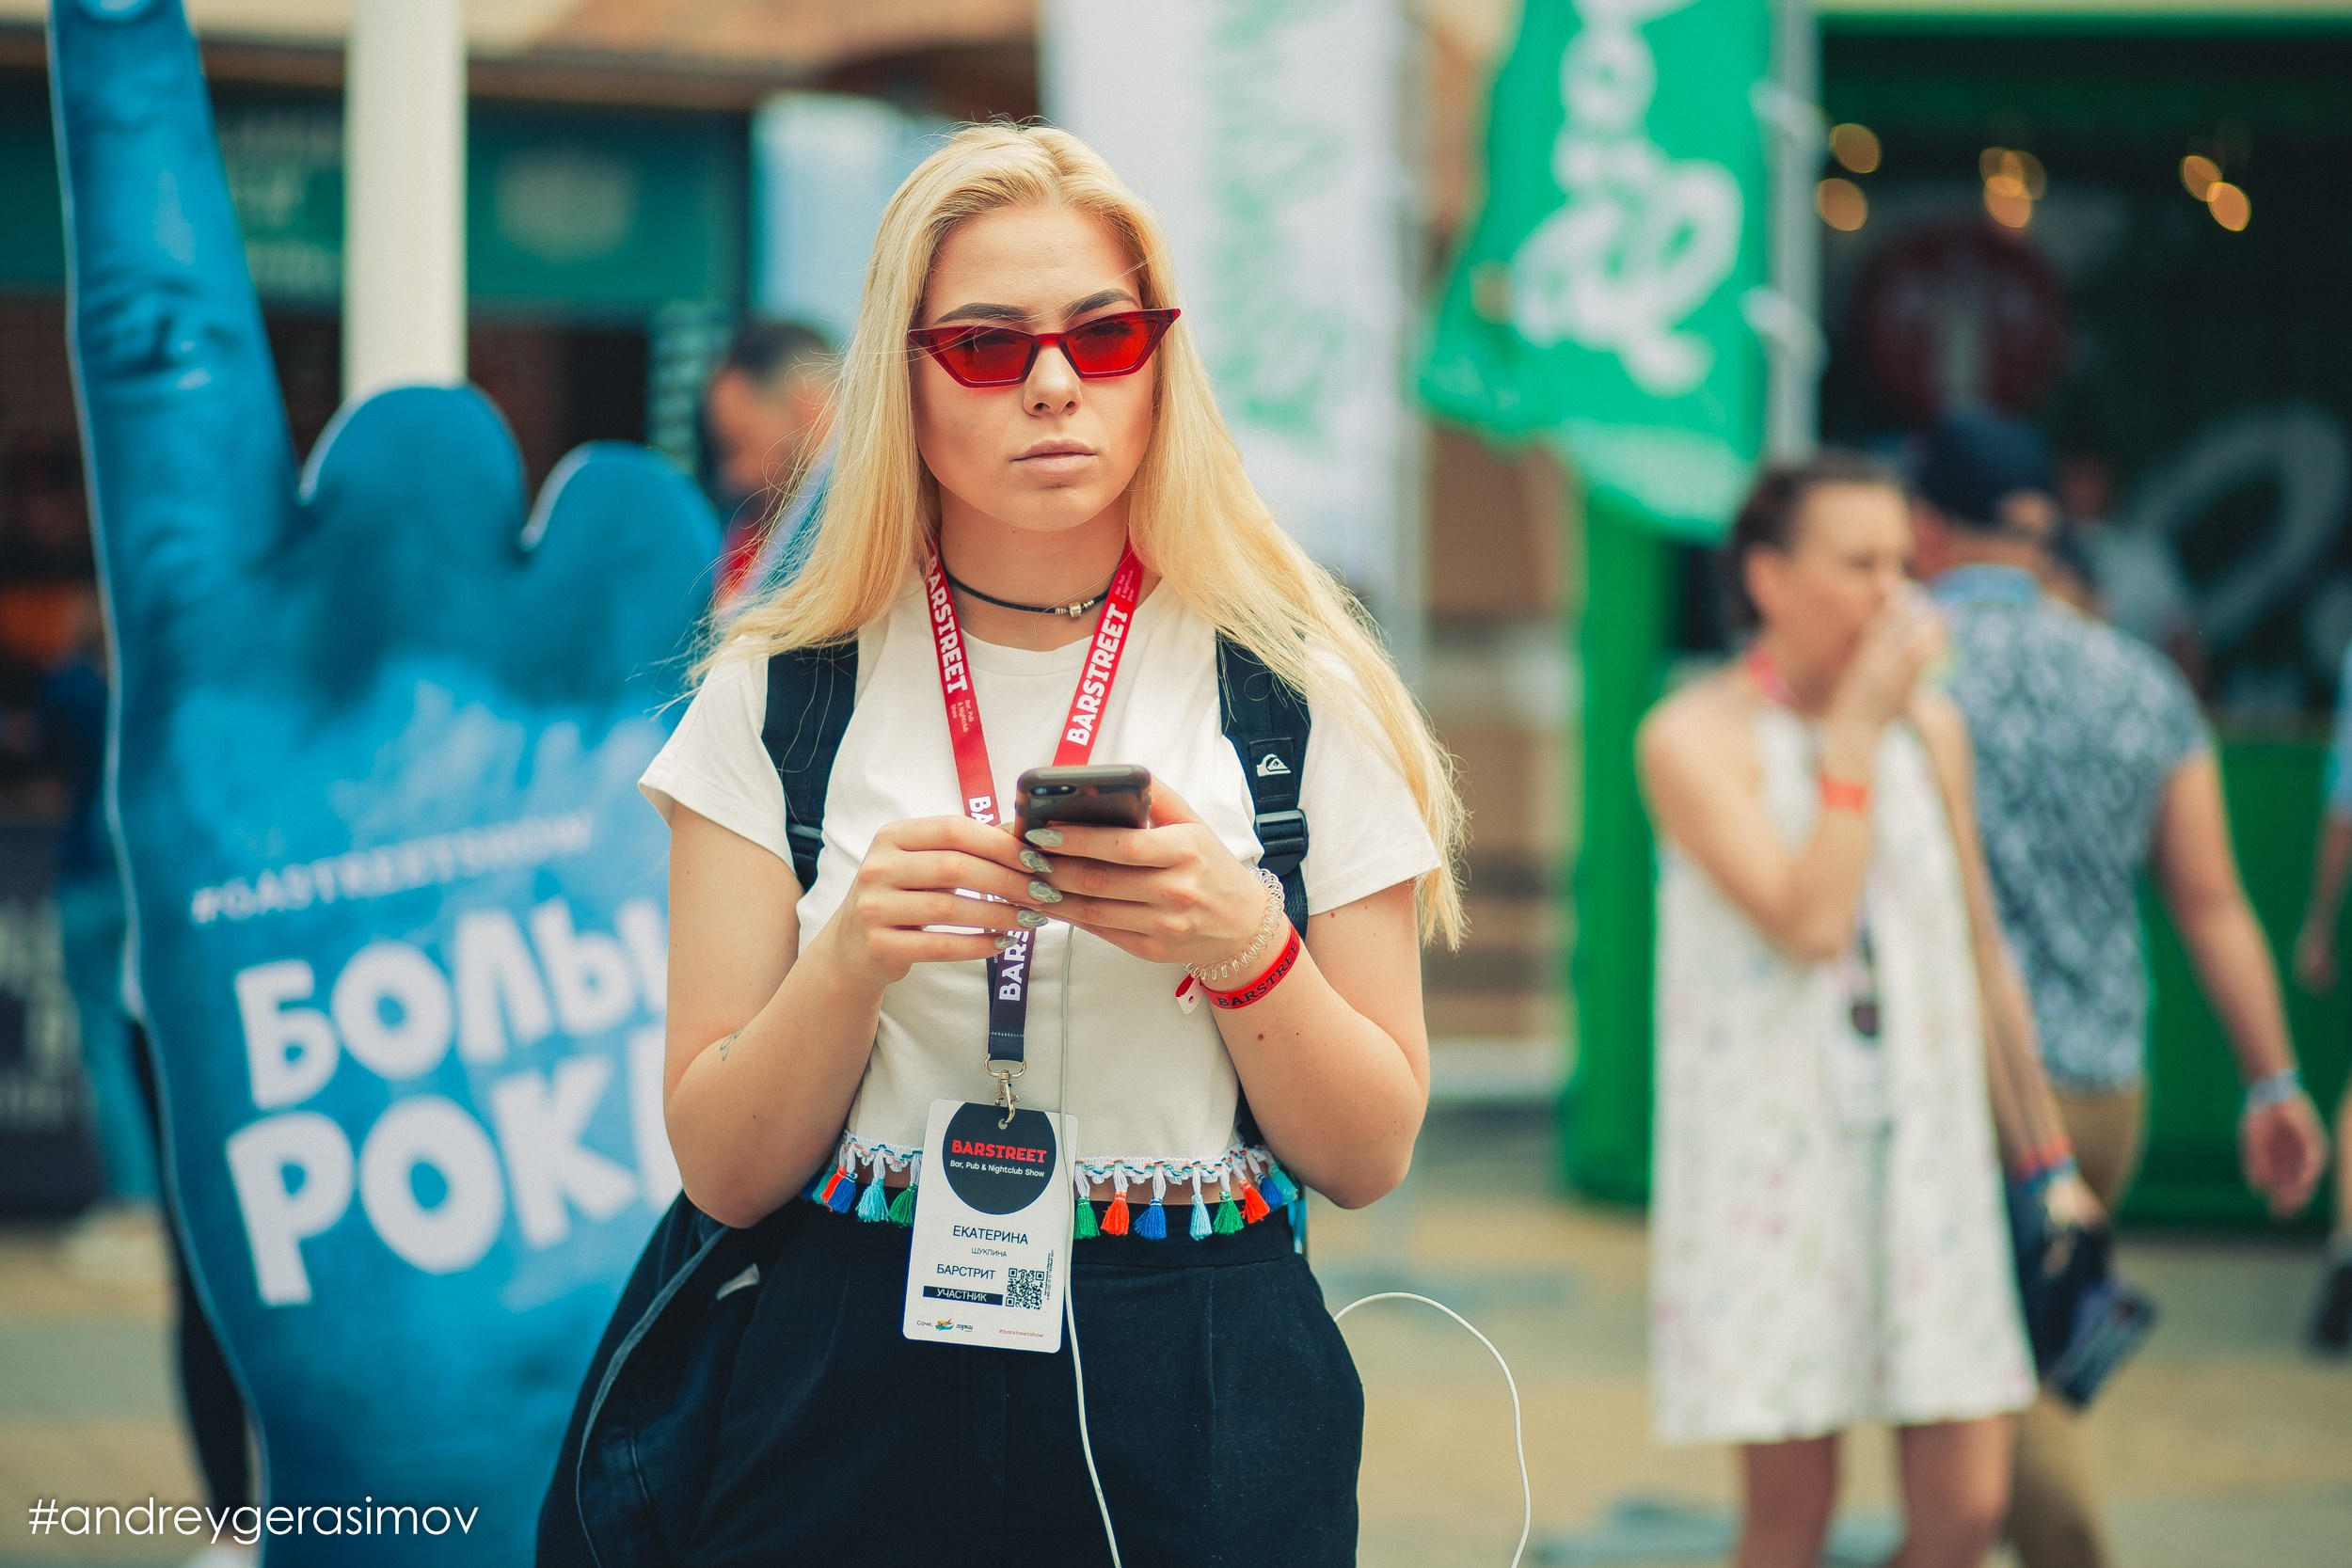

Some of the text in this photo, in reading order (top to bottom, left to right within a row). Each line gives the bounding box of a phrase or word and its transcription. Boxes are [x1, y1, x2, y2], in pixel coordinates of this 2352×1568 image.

[929, 555, 968, 694] BARSTREET
[1065, 602, 1128, 746] BARSTREET
[1216, 930, 1300, 1007] BARSTREET
[951, 1139, 1047, 1164] BARSTREET
[949, 1160, 964, 1169] Bar,
[965, 1161, 980, 1170] Pub
[988, 1164, 1023, 1175] Nightclub
[1025, 1168, 1045, 1178] Show
[952, 1225, 1028, 1245] ЕКАТЕРИНА
[936, 1263, 996, 1280] БАРСТРИТ
[936, 1288, 988, 1303] УЧАСТНИК
[998, 1328, 1044, 1338] #barstreetshow
